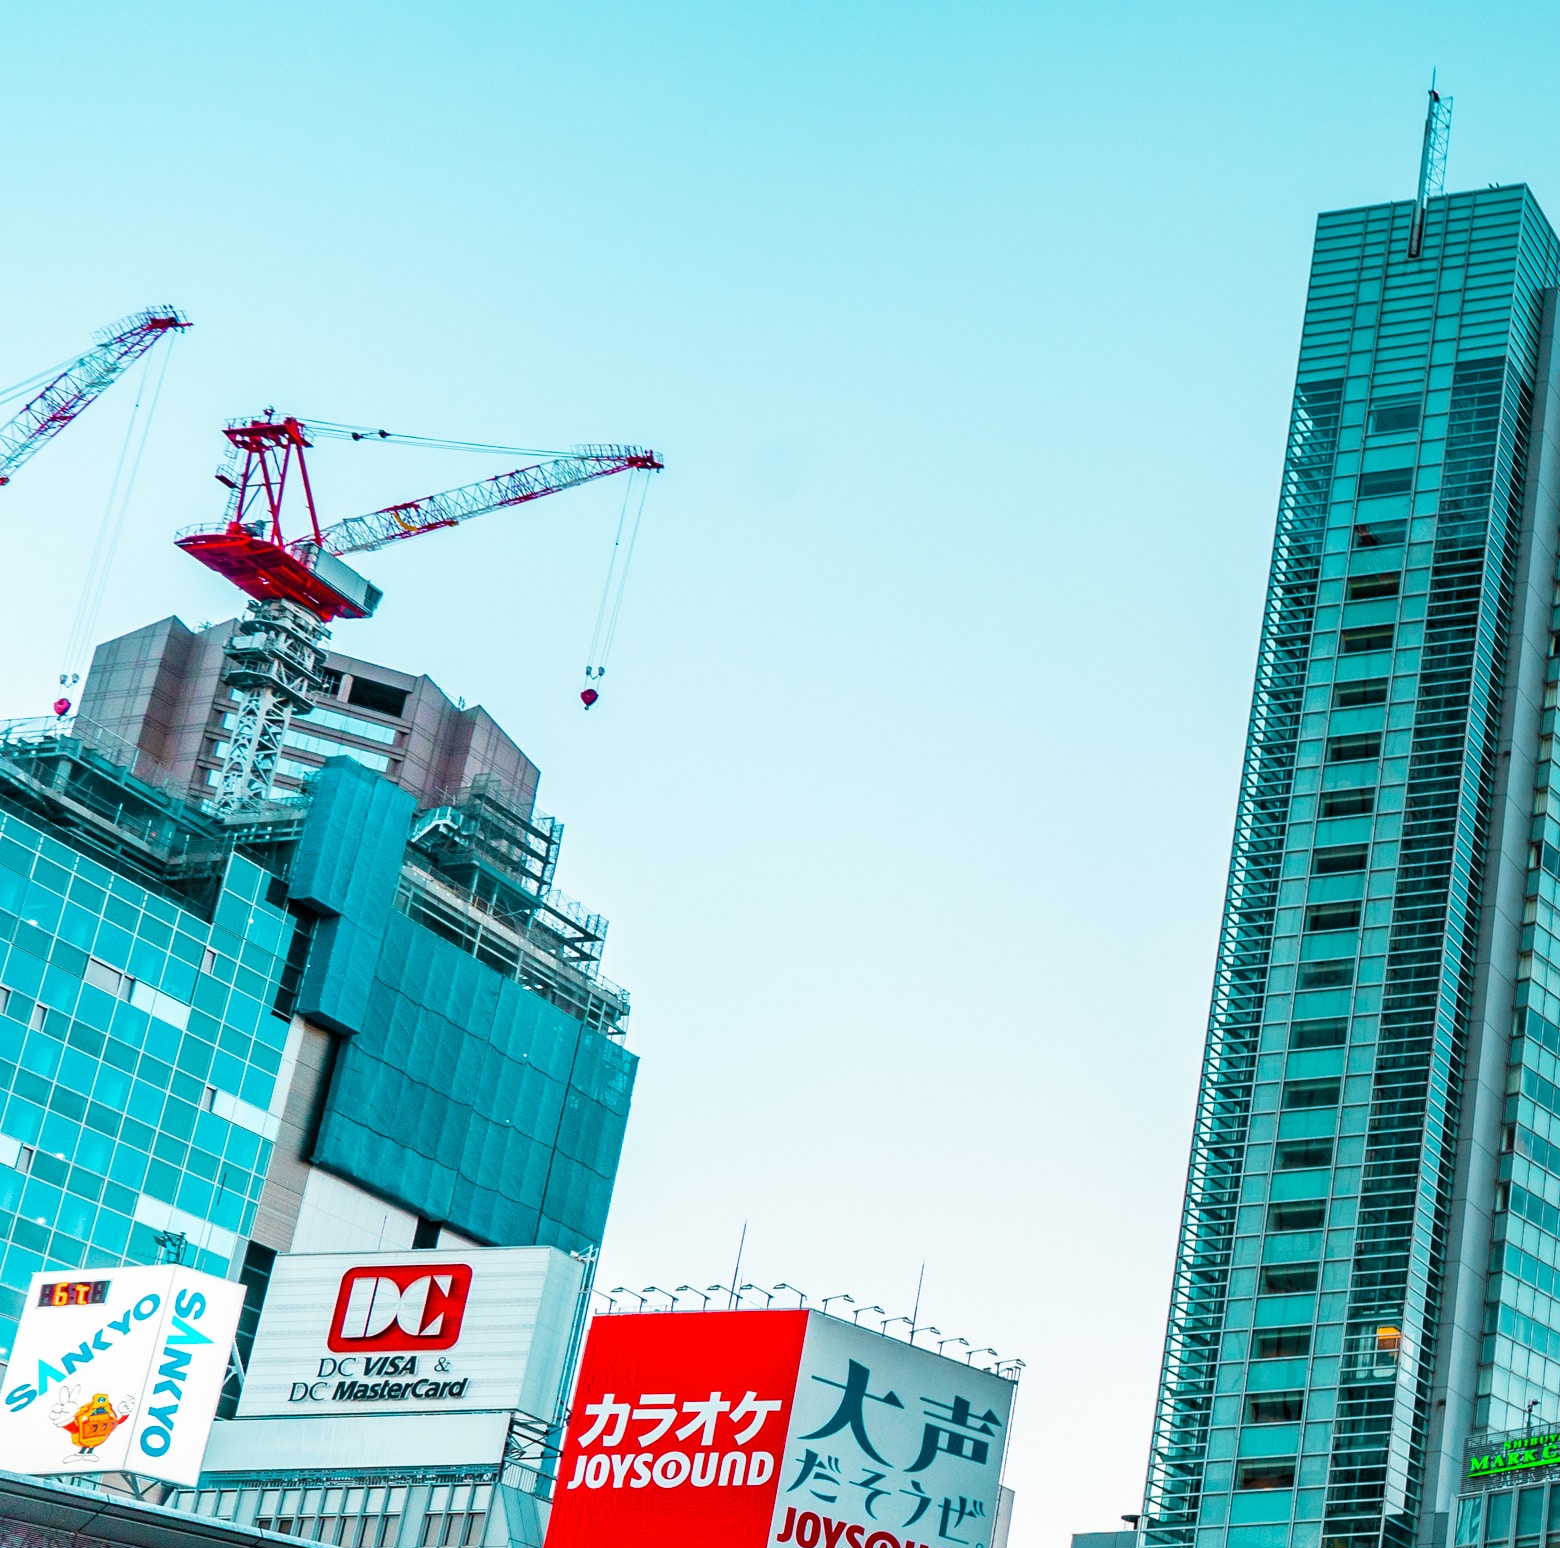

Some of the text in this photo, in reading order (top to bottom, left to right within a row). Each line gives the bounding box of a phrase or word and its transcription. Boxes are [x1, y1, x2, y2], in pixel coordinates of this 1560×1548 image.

[340, 1275, 454, 1339] DC
[10, 1292, 161, 1414] SANKYO
[141, 1288, 214, 1458] SANKYO
[317, 1357, 359, 1378] DC
[362, 1356, 419, 1376] VISA
[288, 1377, 468, 1402] DC MasterCard
[797, 1359, 1003, 1473] 大声
[577, 1391, 784, 1449] カラオケ
[567, 1452, 775, 1489] JOYSOUND
[1469, 1449, 1538, 1473] MARK
